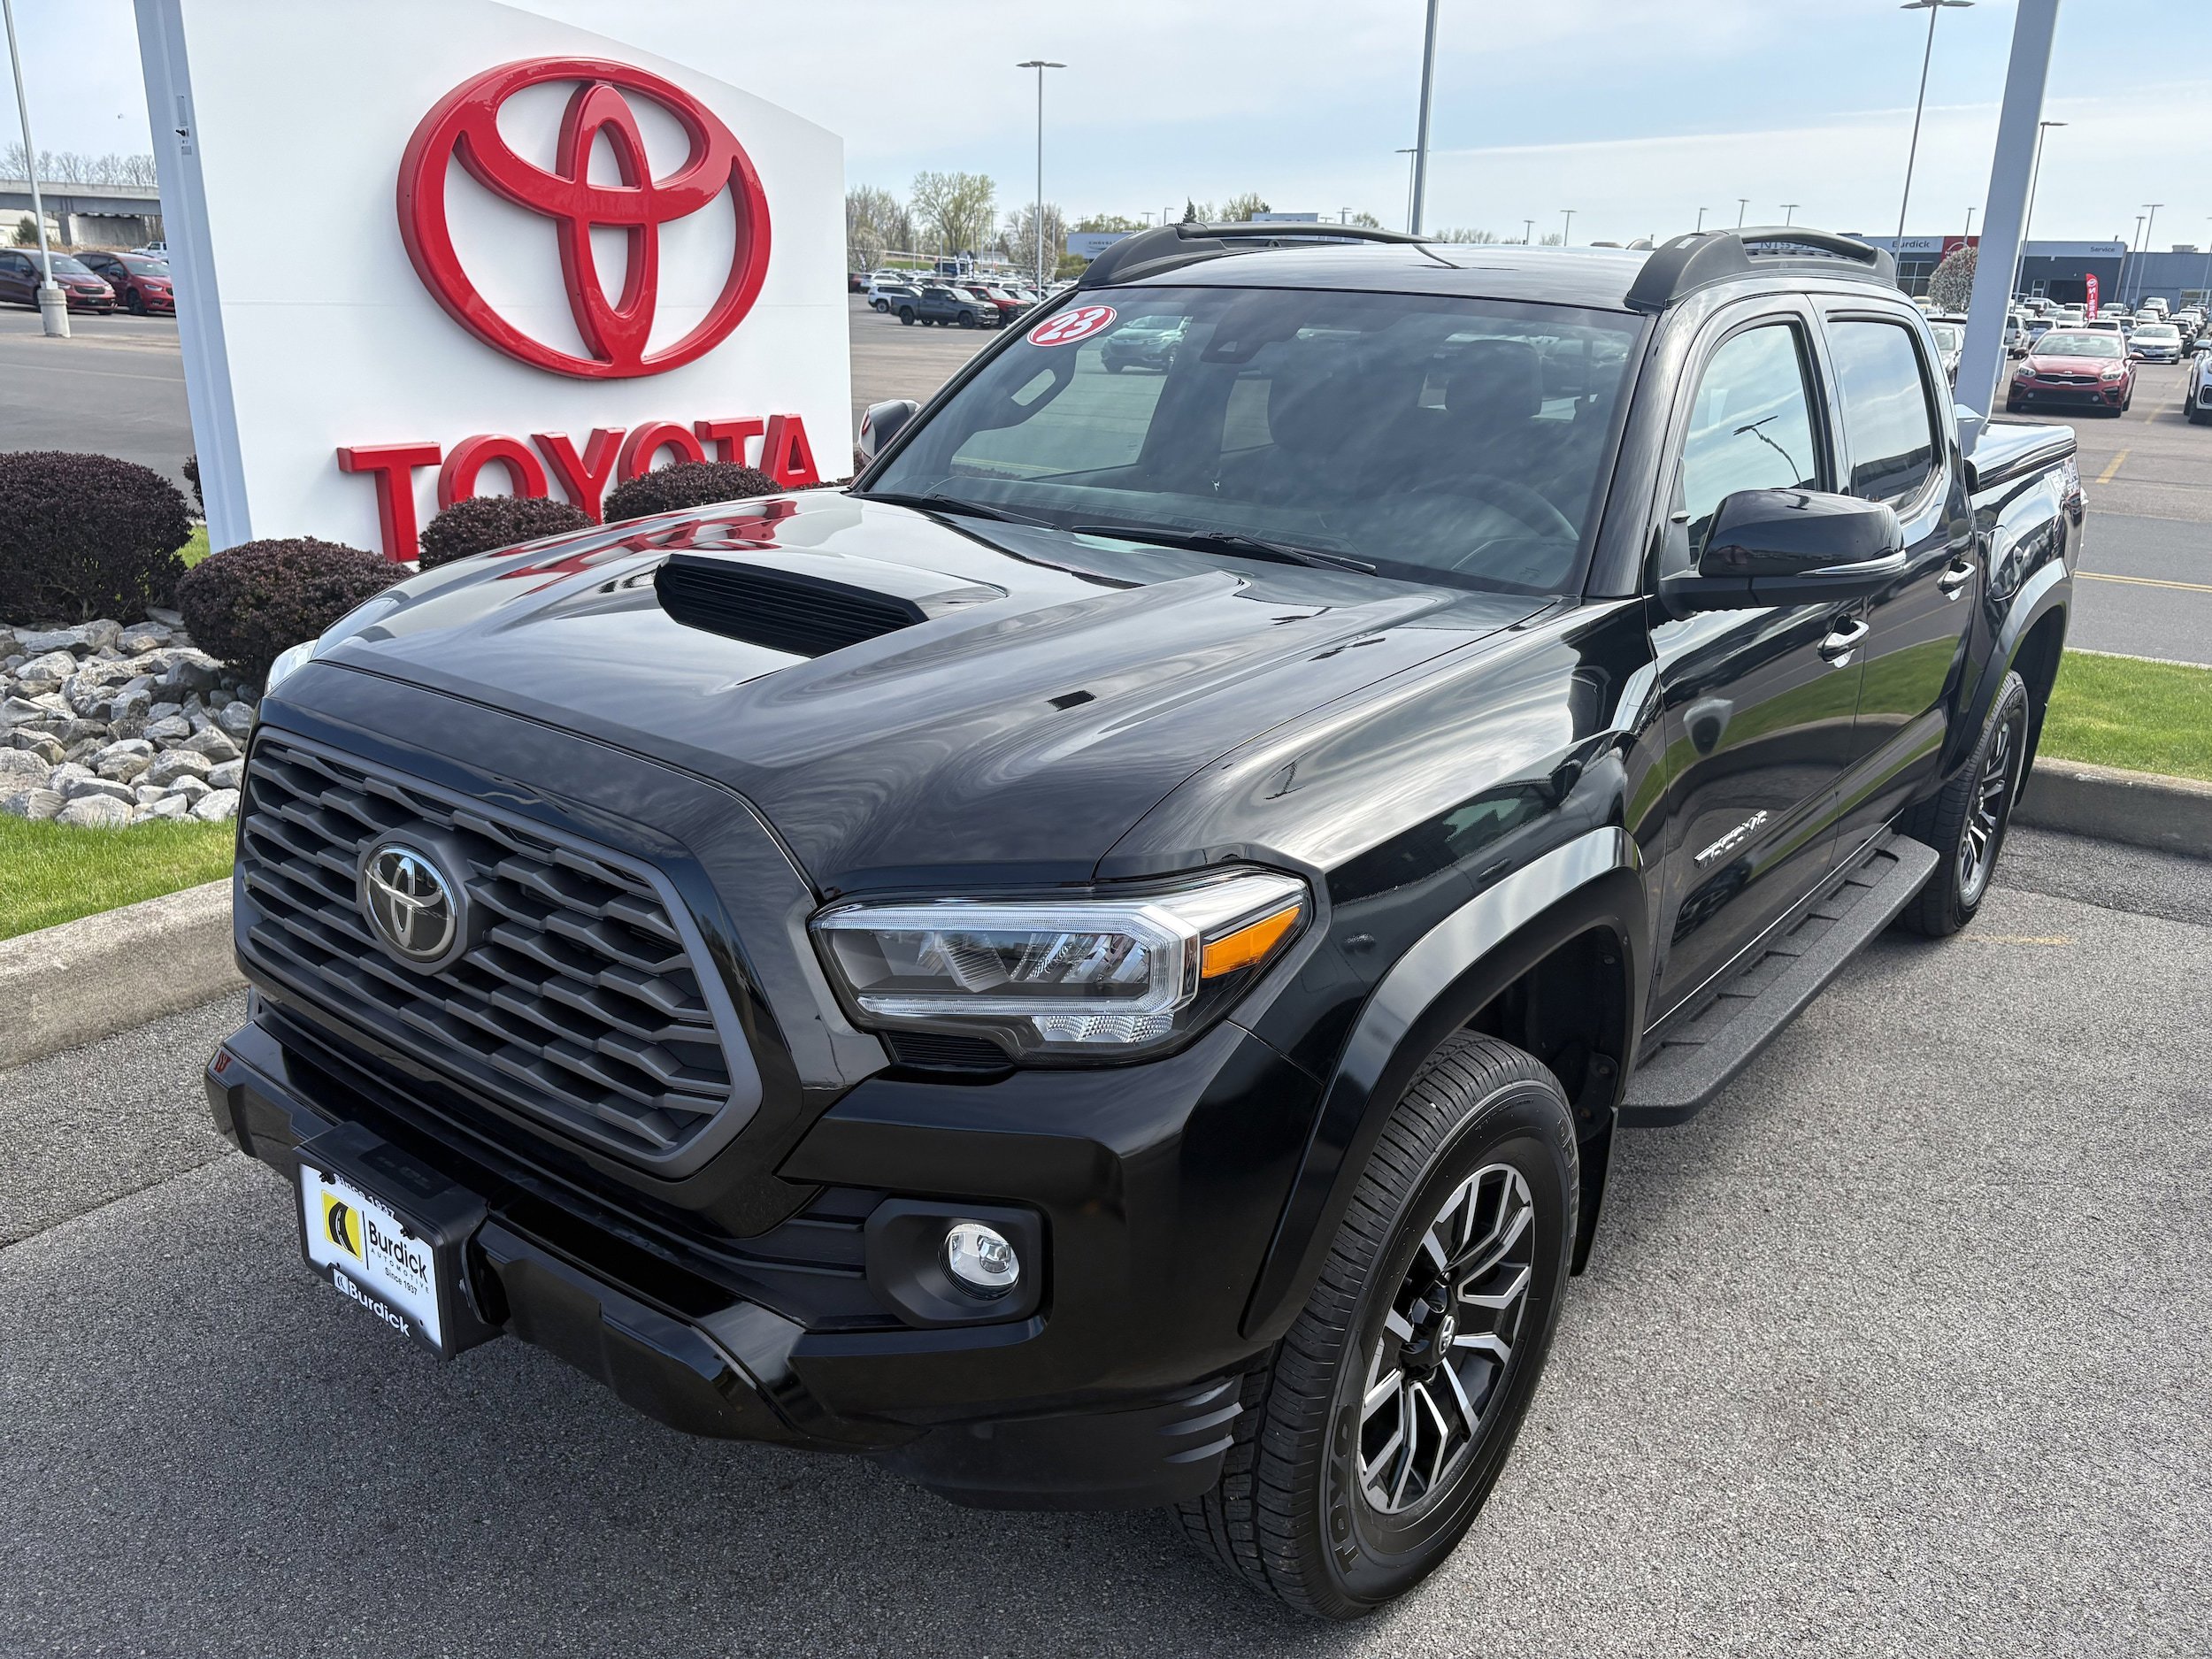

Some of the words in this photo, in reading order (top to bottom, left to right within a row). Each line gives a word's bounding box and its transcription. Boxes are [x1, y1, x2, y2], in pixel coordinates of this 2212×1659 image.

[1036, 308, 1106, 342] 23
[337, 413, 820, 564] TOYOTA
[333, 1172, 365, 1198] Since
[368, 1195, 396, 1219] 1937
[368, 1219, 428, 1284] Burdick
[371, 1248, 429, 1294] AUTOMOTIVE
[384, 1267, 403, 1286] Since
[403, 1280, 418, 1296] 1937
[349, 1280, 411, 1338] Burdick
[1329, 1403, 1360, 1576] TOYO
